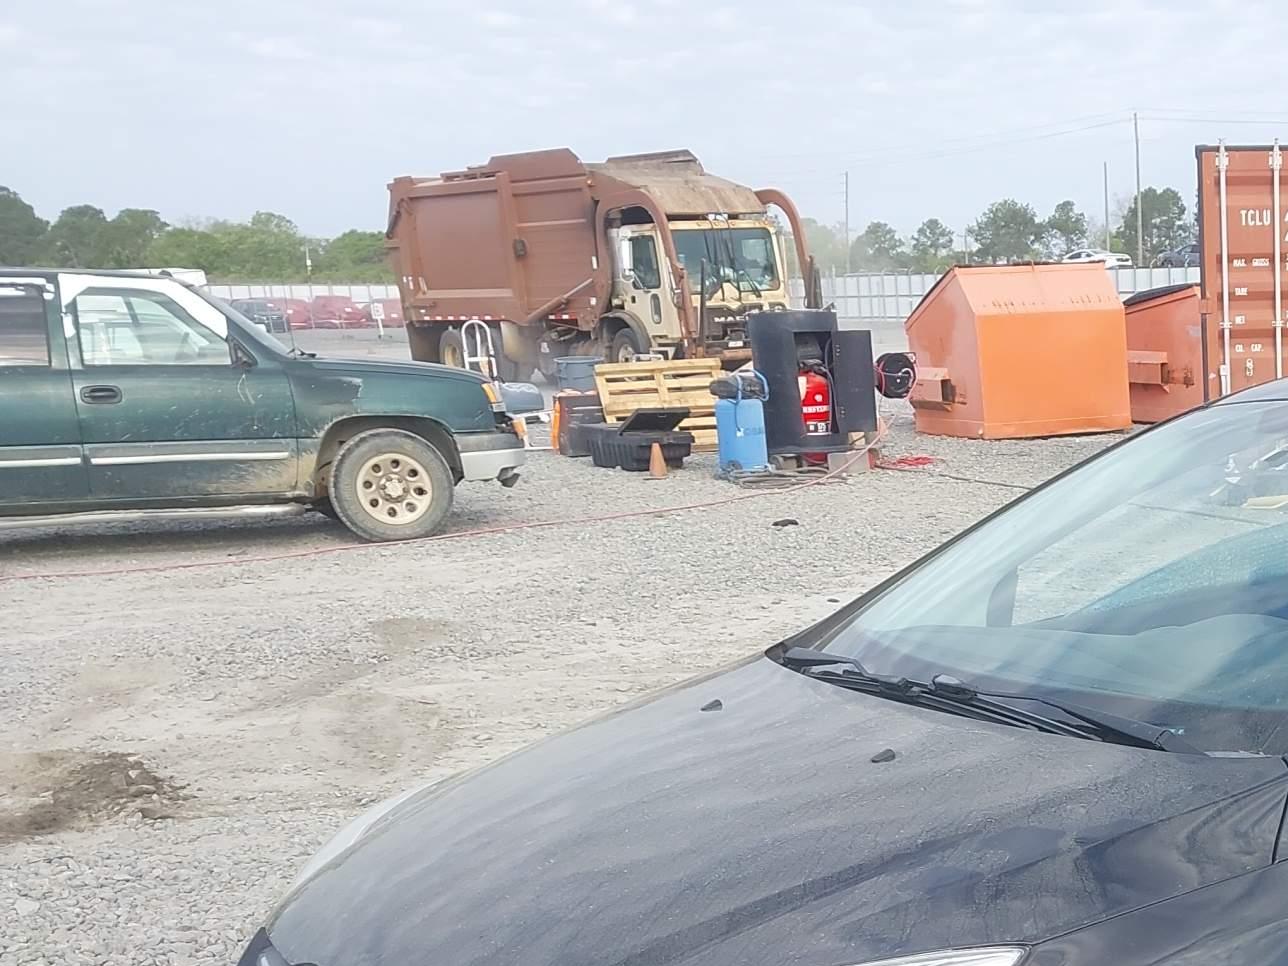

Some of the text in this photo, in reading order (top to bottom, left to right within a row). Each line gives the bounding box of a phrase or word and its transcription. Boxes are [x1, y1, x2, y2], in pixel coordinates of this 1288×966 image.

[1240, 209, 1271, 226] TCLU
[1233, 258, 1270, 267] MAX. GROSS
